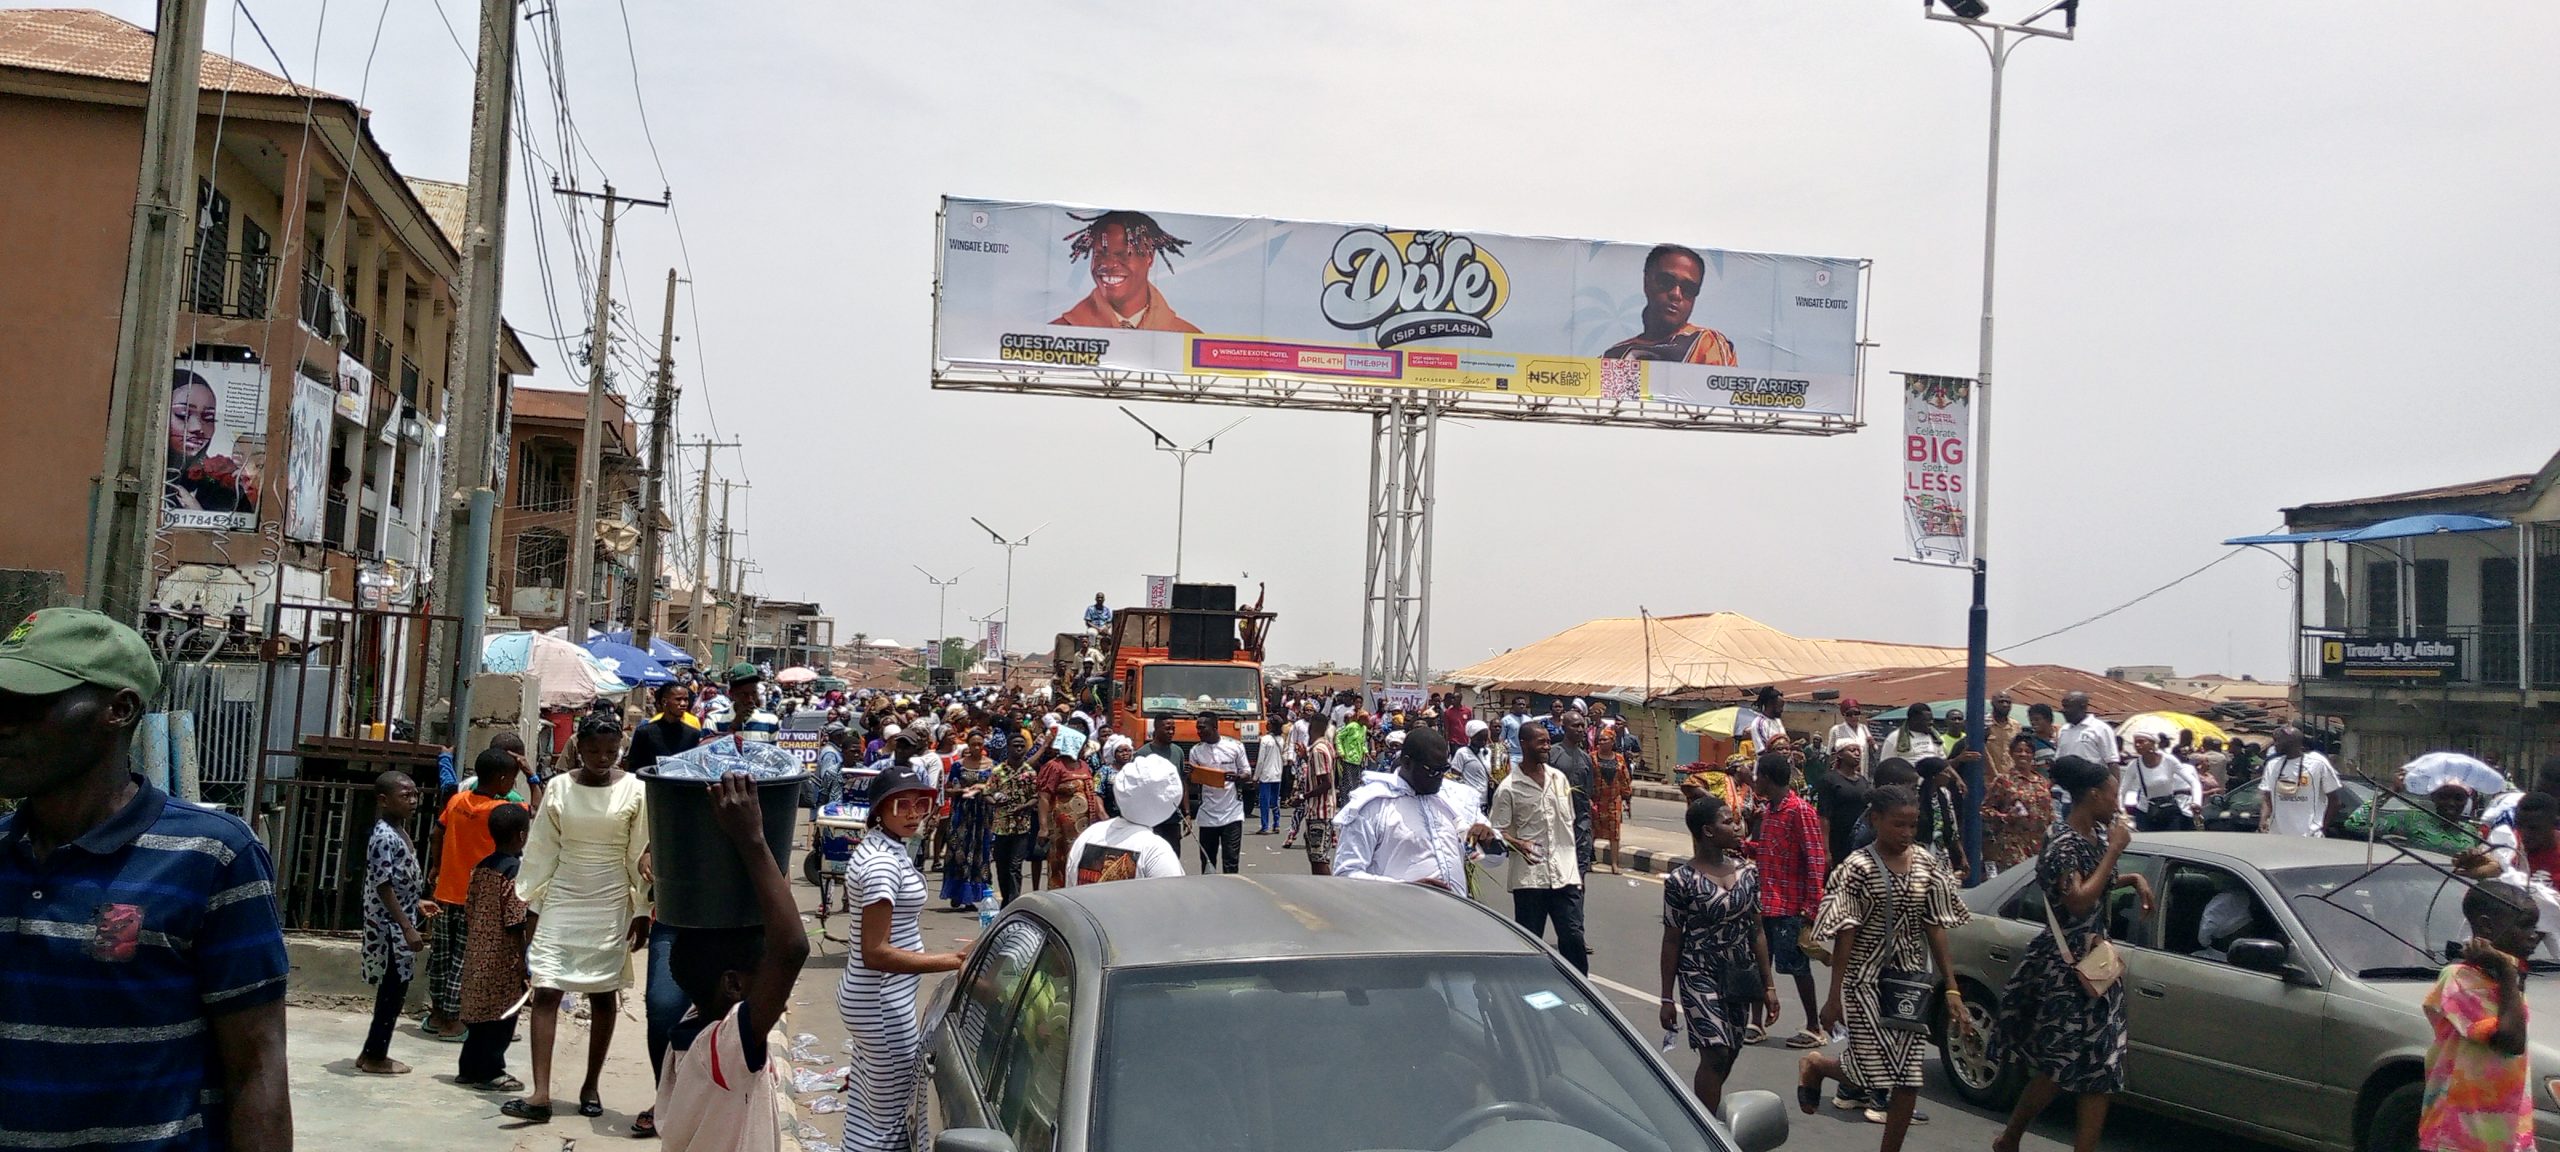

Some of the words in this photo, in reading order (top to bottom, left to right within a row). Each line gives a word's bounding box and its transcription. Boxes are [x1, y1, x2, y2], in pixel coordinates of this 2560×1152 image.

[949, 238, 982, 252] WINGATE
[983, 242, 1009, 254] EXOTIC
[1321, 228, 1497, 330] Dive
[1795, 296, 1824, 309] WINGATE
[1825, 298, 1849, 310] EXOTIC
[1391, 329, 1415, 342] (SIP
[1419, 325, 1427, 336] &
[1429, 323, 1480, 337] SPLASH)
[1001, 333, 1054, 348] GUEST
[1055, 338, 1109, 354] ARTIST
[1001, 348, 1101, 366] BADBOYTIMZ
[1219, 348, 1247, 356] WINGATE
[1247, 350, 1269, 358] EXOTIC
[1269, 351, 1288, 359] HOTEL
[1300, 356, 1325, 365] APRIL
[1327, 357, 1343, 366] 4TH
[1560, 370, 1589, 380] EARLY
[1560, 378, 1581, 387] BIRD
[1707, 375, 1757, 391] GUEST
[1757, 379, 1809, 395] ARTIST
[1730, 391, 1806, 408] ASHIDAPO
[1915, 426, 1956, 438] Celebrate
[1908, 435, 1963, 465] BIG
[1908, 471, 1962, 493] LESS
[2345, 642, 2396, 661] Trendy
[2393, 641, 2416, 661] By
[2414, 640, 2455, 656] Aisha
[777, 741, 819, 749] ECHARGE
[786, 750, 817, 762] ARD
